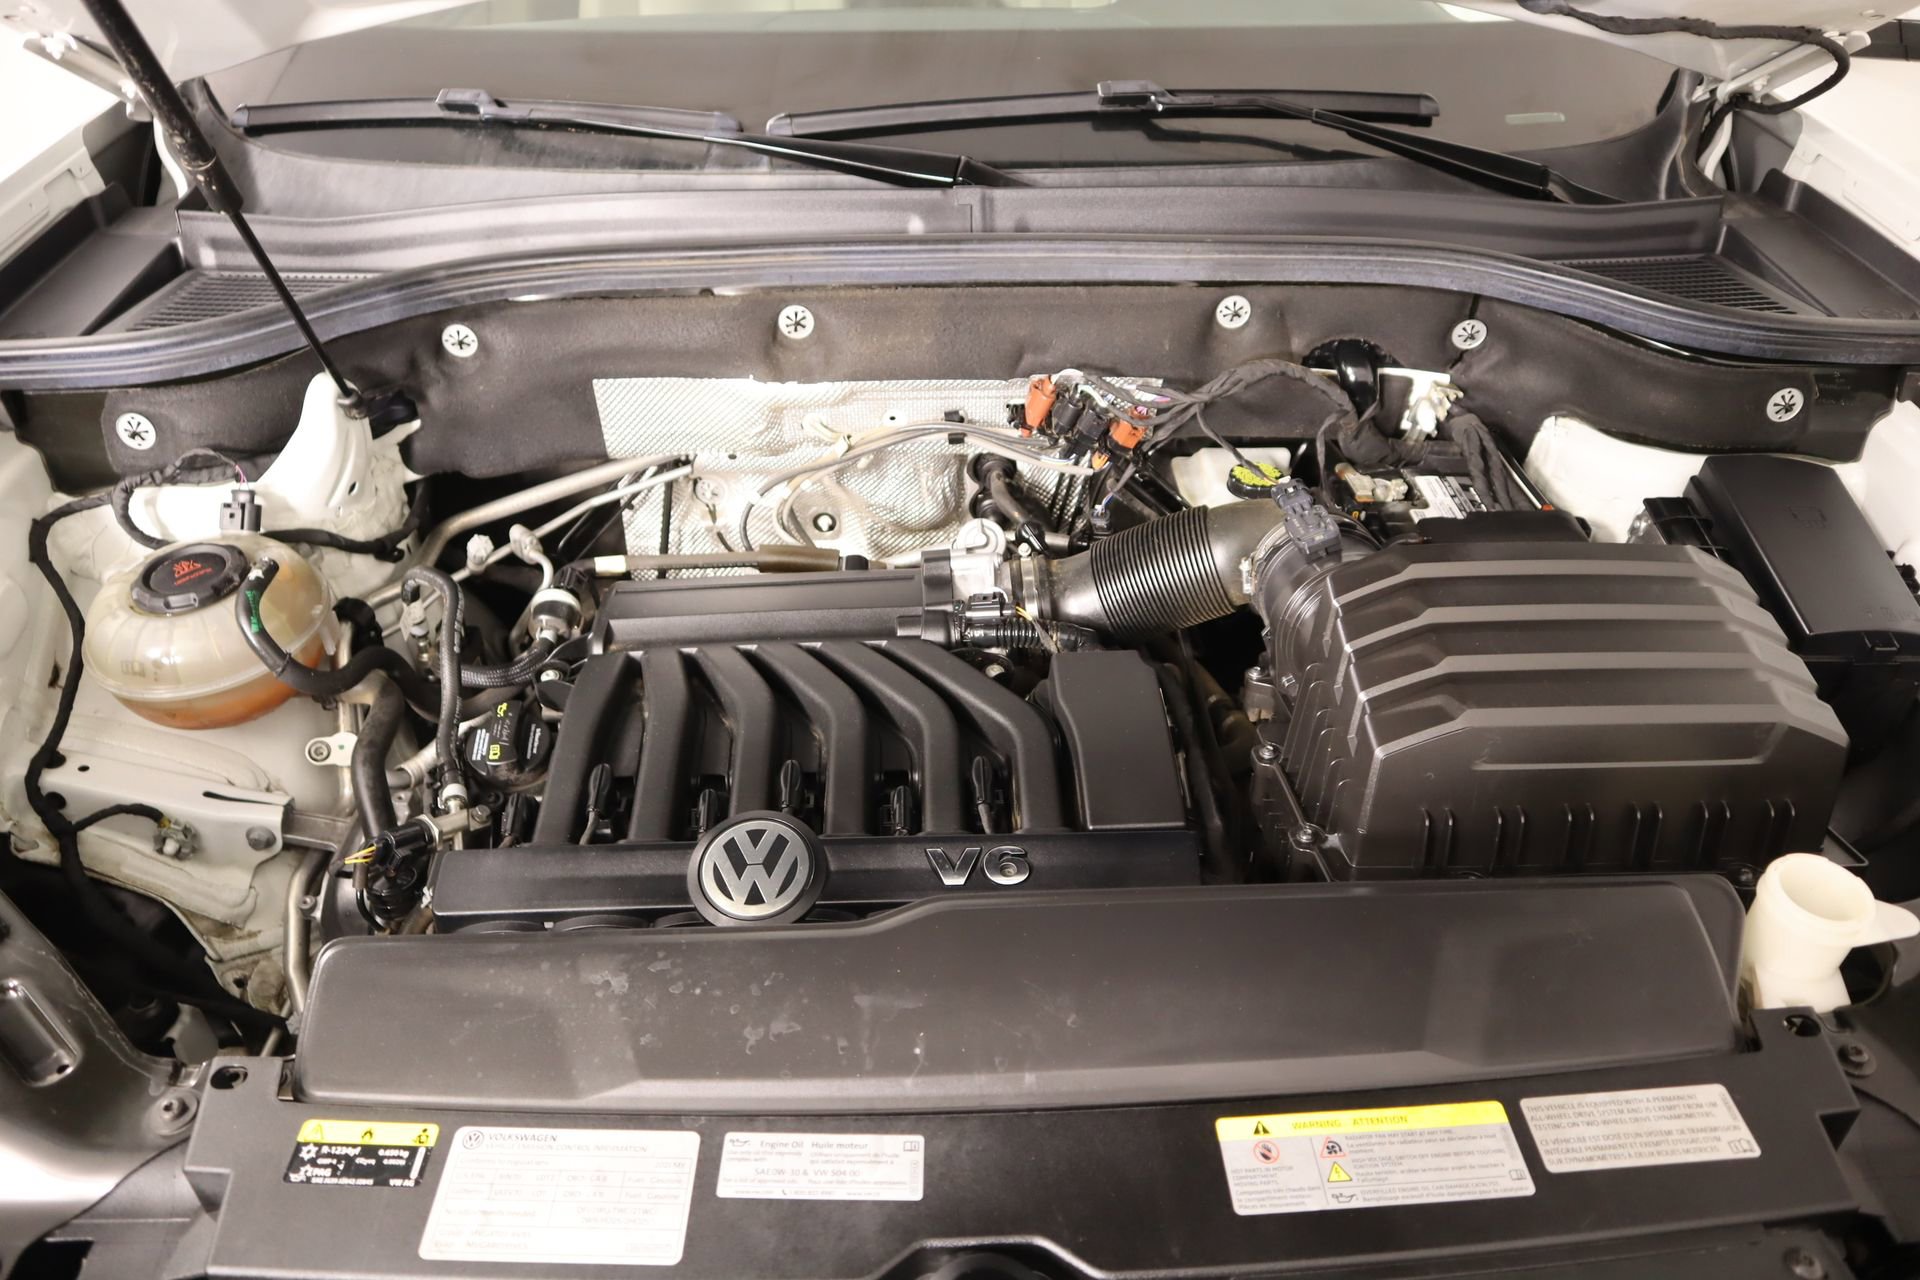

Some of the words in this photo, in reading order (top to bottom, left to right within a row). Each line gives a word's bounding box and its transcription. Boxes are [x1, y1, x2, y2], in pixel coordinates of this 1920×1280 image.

[924, 844, 1032, 887] V6
[1526, 1105, 1544, 1113] THIS
[1544, 1103, 1576, 1112] VEHICLE
[1585, 1099, 1623, 1108] EQUIPPED
[1652, 1094, 1697, 1103] PERMANENT
[1573, 1111, 1597, 1119] DRIVE
[1597, 1108, 1625, 1116] SYSTEM
[1627, 1106, 1644, 1114] AND
[1653, 1104, 1681, 1112] EXEMPT
[1291, 1119, 1342, 1129] WARNING
[1352, 1115, 1408, 1125] ATTENTION
[1533, 1122, 1566, 1131] TESTING
[488, 1133, 558, 1142] VOLKSWAGEN
[759, 1140, 789, 1150] Engine
[791, 1140, 804, 1149] Oil
[811, 1141, 834, 1149] Huile
[1547, 1158, 1563, 1166] SUR
[802, 1168, 809, 1176] &
[830, 1169, 847, 1177] 504
